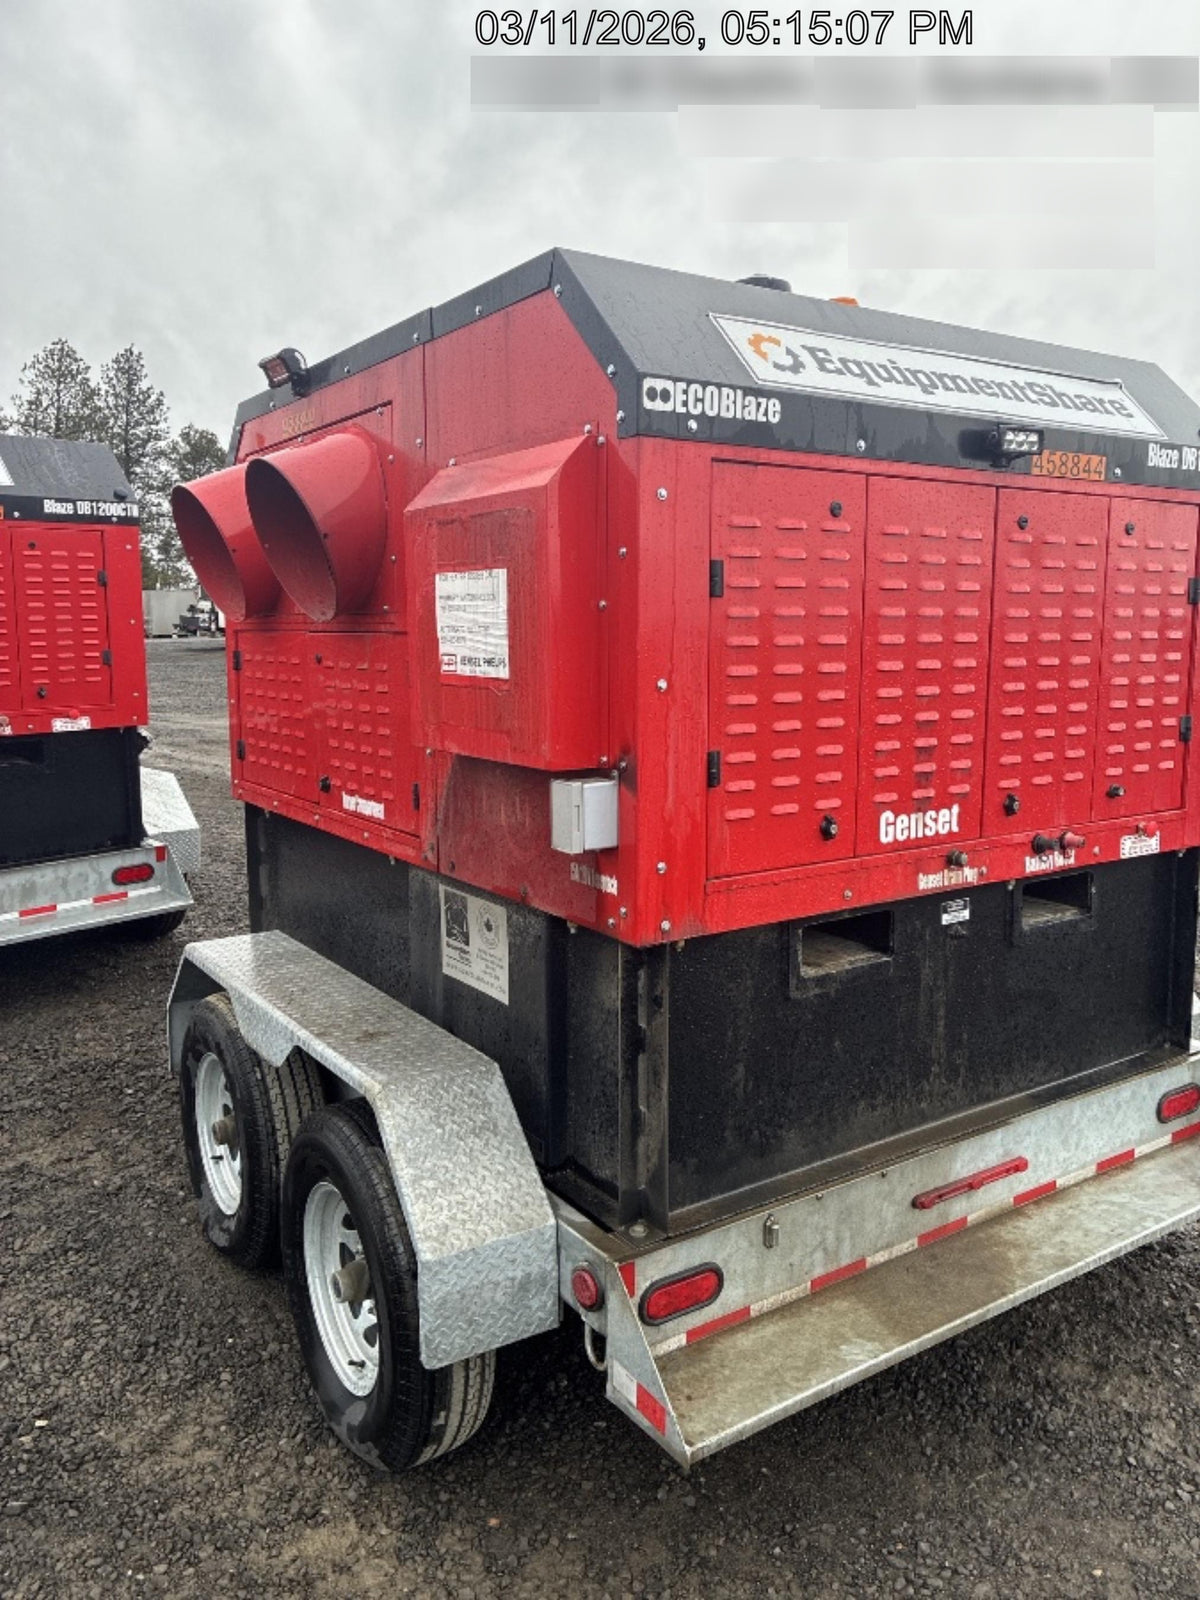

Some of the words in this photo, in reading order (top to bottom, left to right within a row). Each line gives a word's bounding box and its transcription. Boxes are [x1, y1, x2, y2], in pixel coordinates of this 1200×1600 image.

[801, 343, 1135, 419] EquipmentShare
[675, 381, 782, 424] ECOBlaze
[1033, 452, 1104, 480] 458844
[1147, 442, 1179, 468] Blaze
[43, 499, 74, 515] Blaze
[879, 803, 960, 844] Genset
